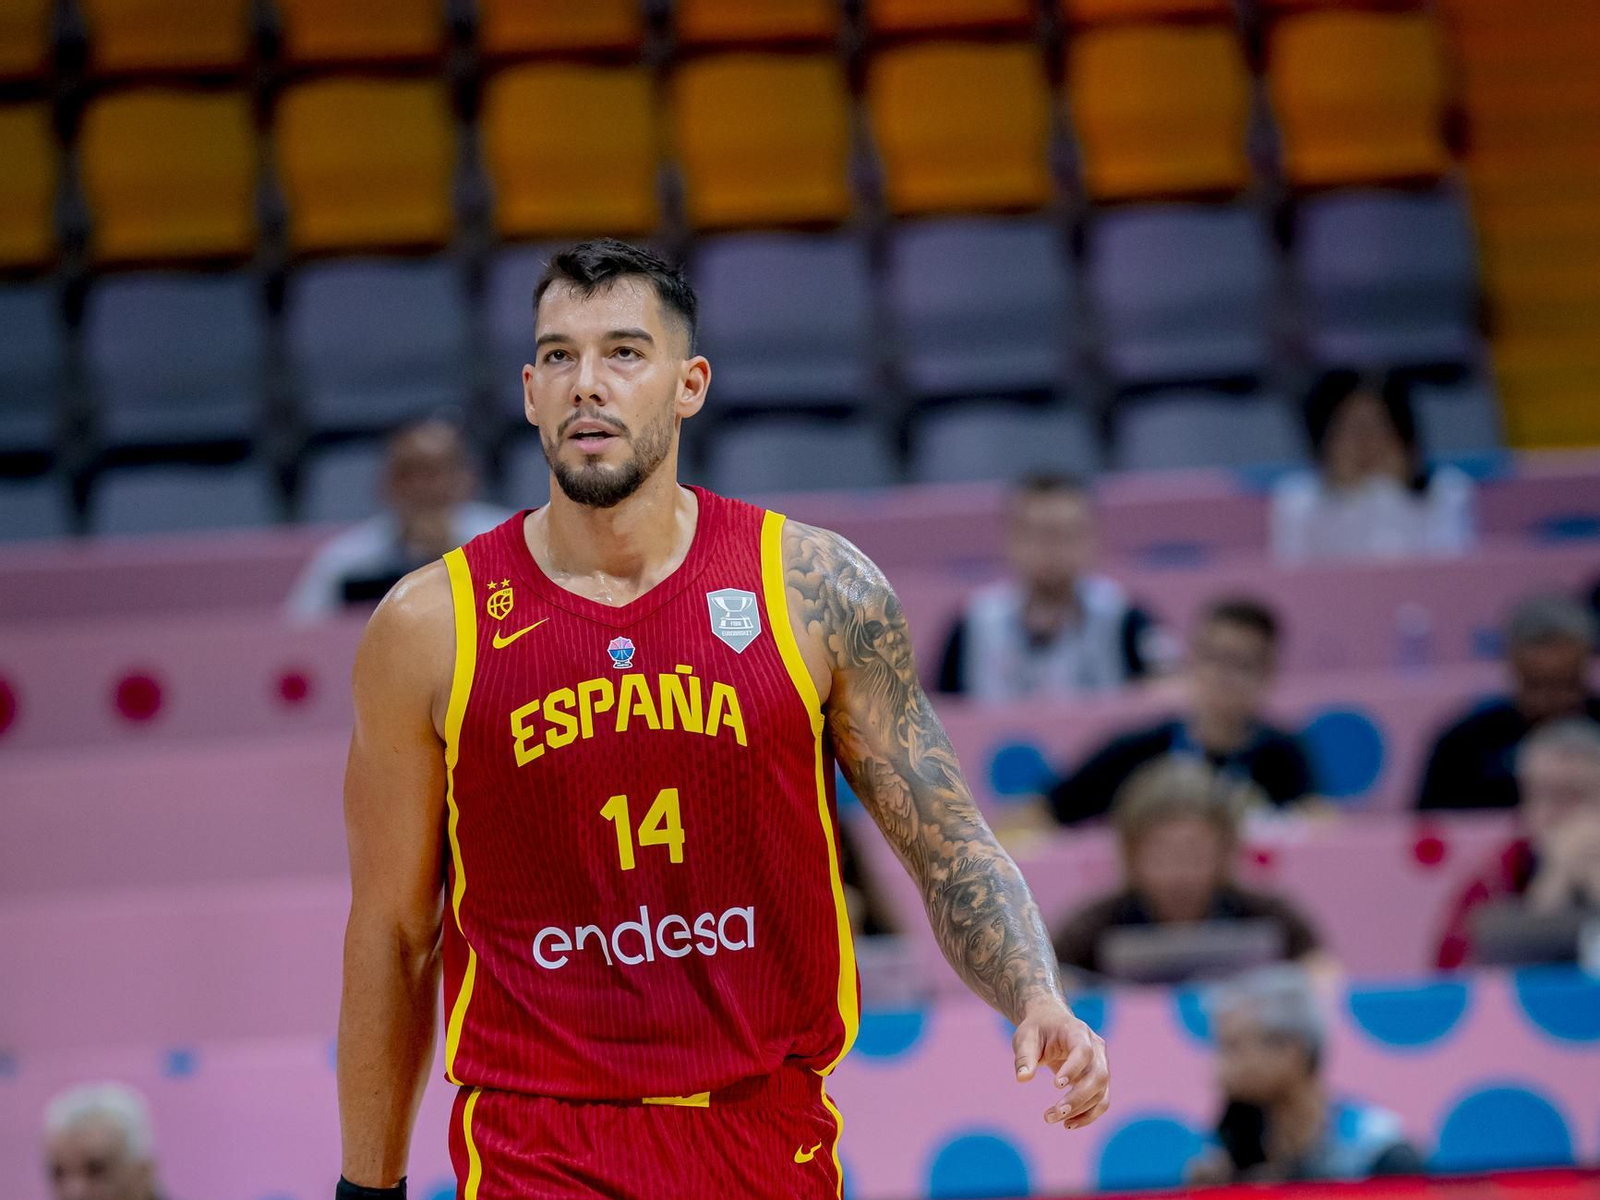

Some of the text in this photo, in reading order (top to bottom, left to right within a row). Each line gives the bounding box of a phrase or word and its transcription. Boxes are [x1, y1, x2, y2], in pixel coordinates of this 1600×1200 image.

[510, 664, 748, 768] ESPAÑA
[600, 788, 686, 871] 14
[532, 905, 756, 970] endesa
